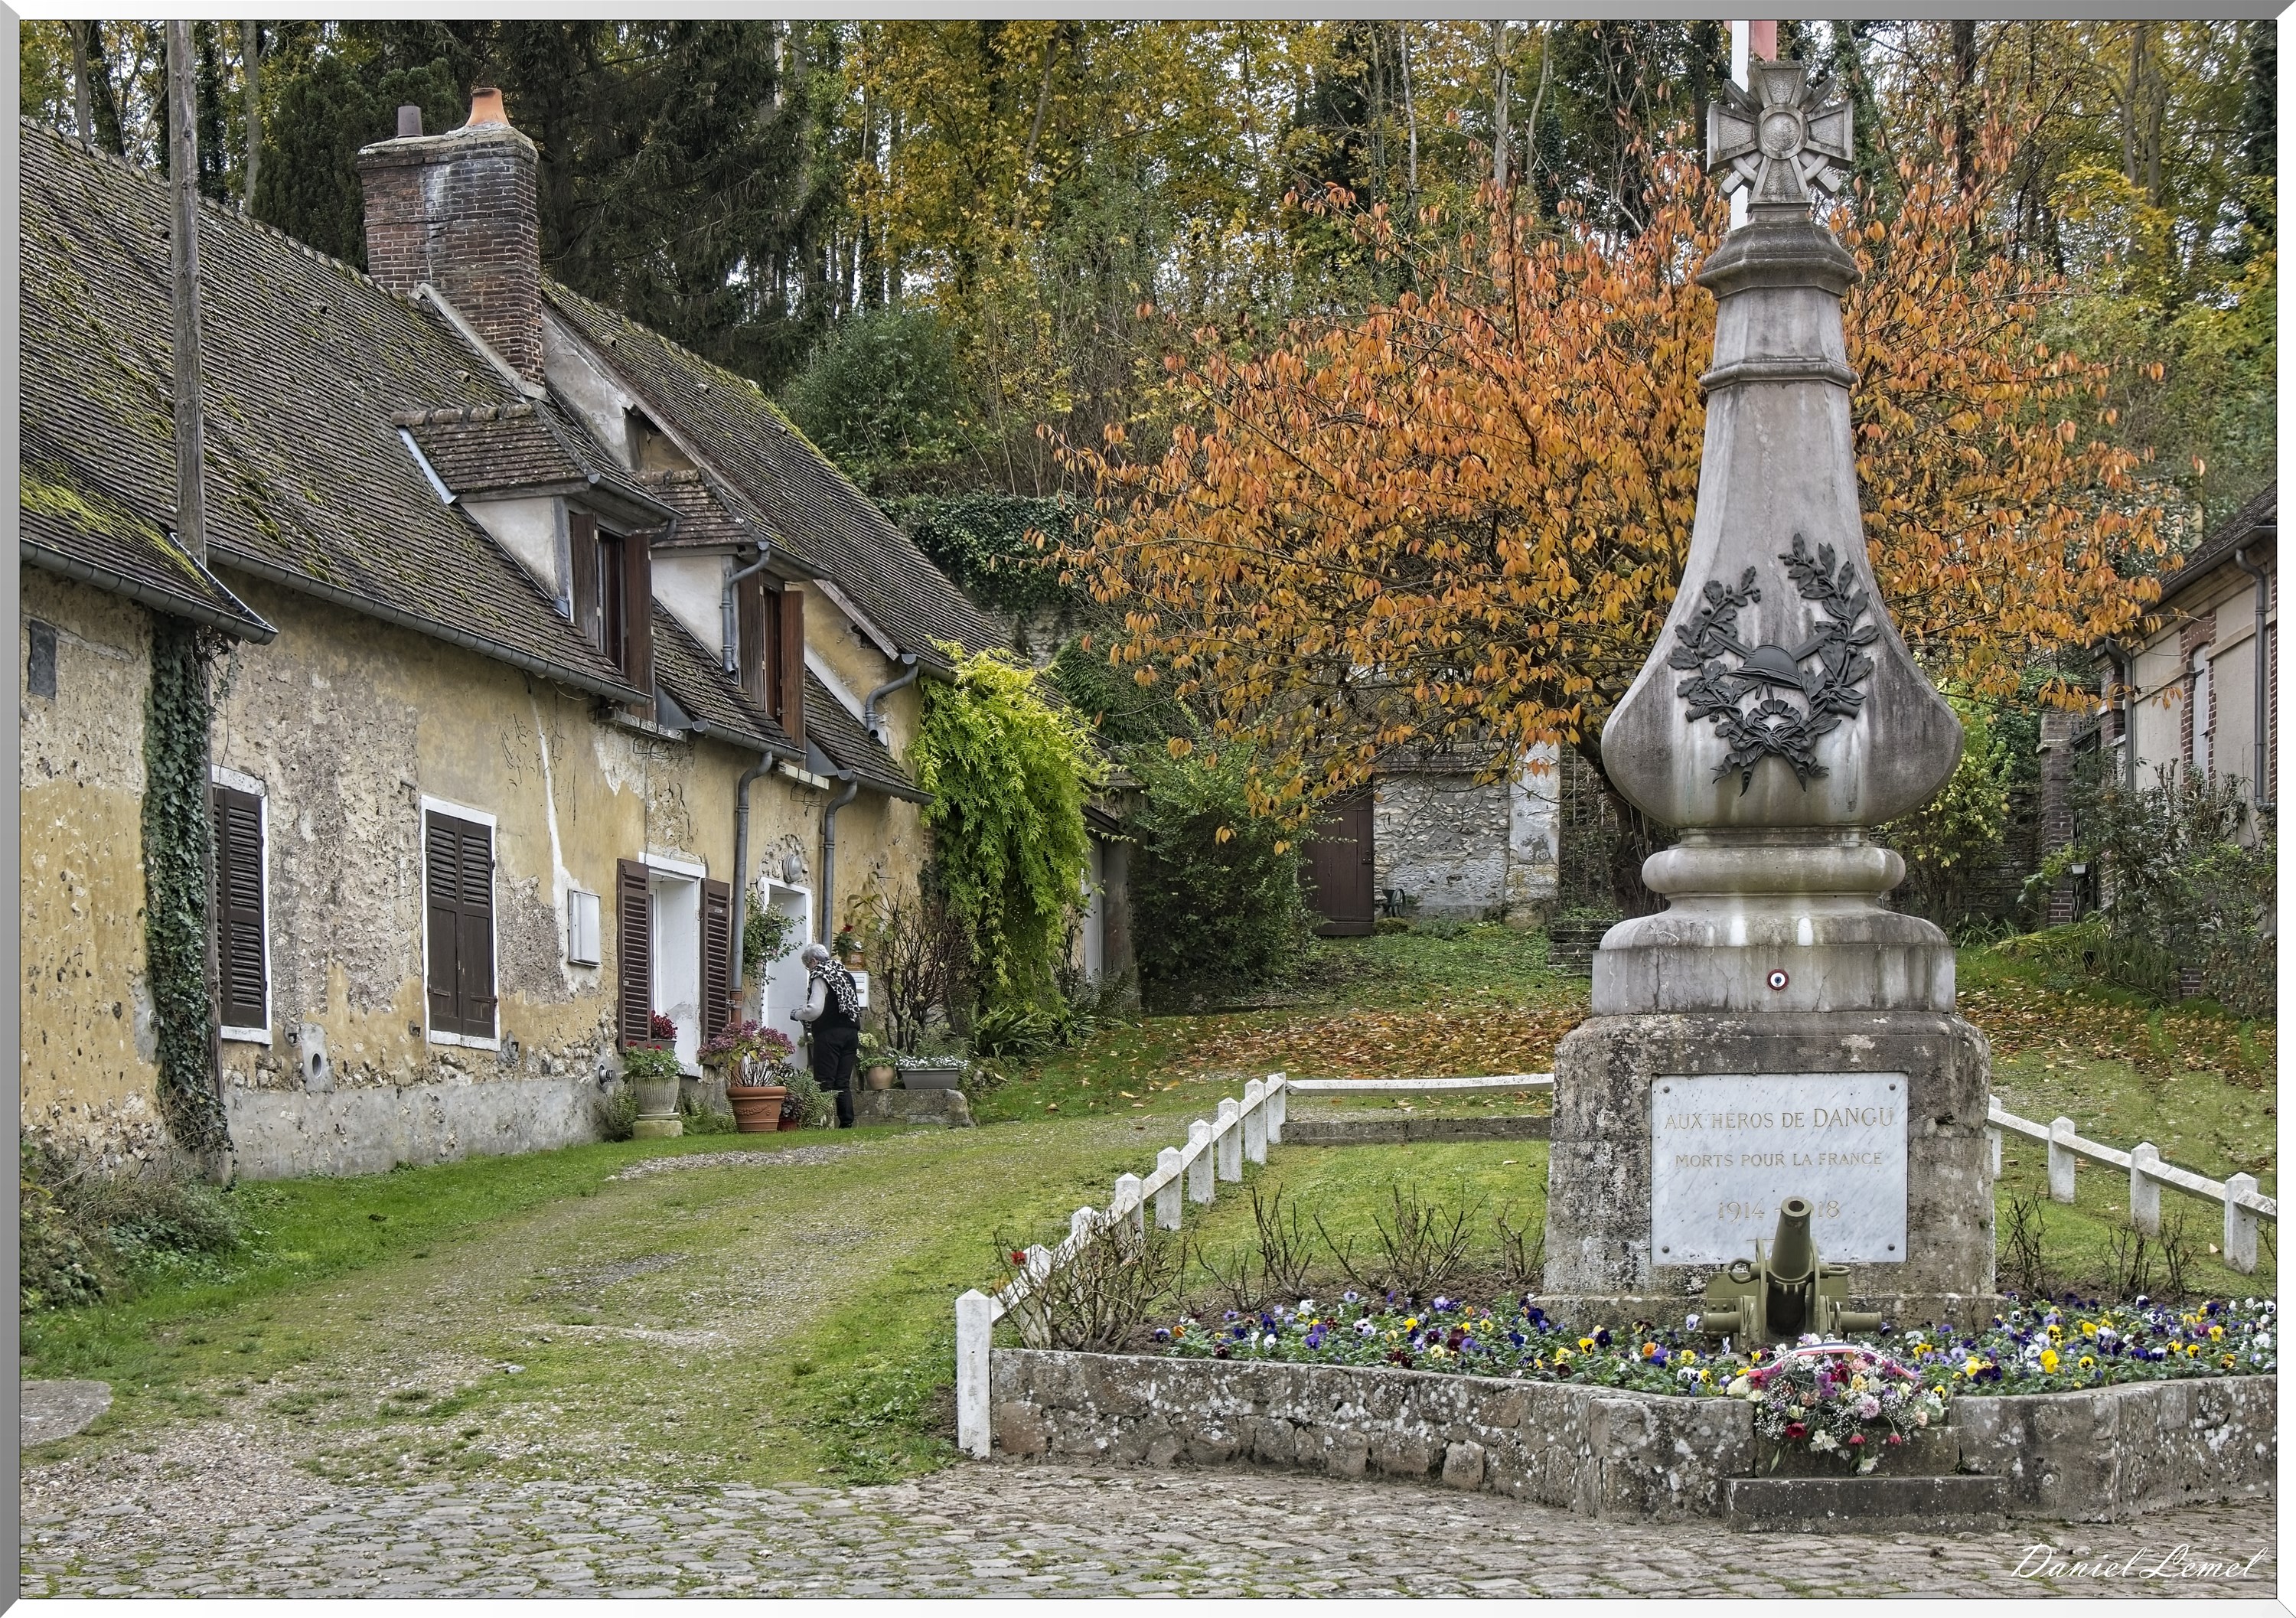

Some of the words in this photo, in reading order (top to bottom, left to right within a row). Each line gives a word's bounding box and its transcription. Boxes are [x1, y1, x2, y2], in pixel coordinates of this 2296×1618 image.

[1665, 1114, 1702, 1130] AUX
[1711, 1112, 1774, 1129] HEROS
[1782, 1112, 1805, 1128] DE
[1813, 1107, 1894, 1127] DANGU
[1675, 1153, 1733, 1168] MORTS
[1741, 1153, 1786, 1167] POUR
[1793, 1153, 1812, 1166] LA
[1818, 1152, 1883, 1166] FRANCE
[1717, 1202, 1765, 1222] 1914
